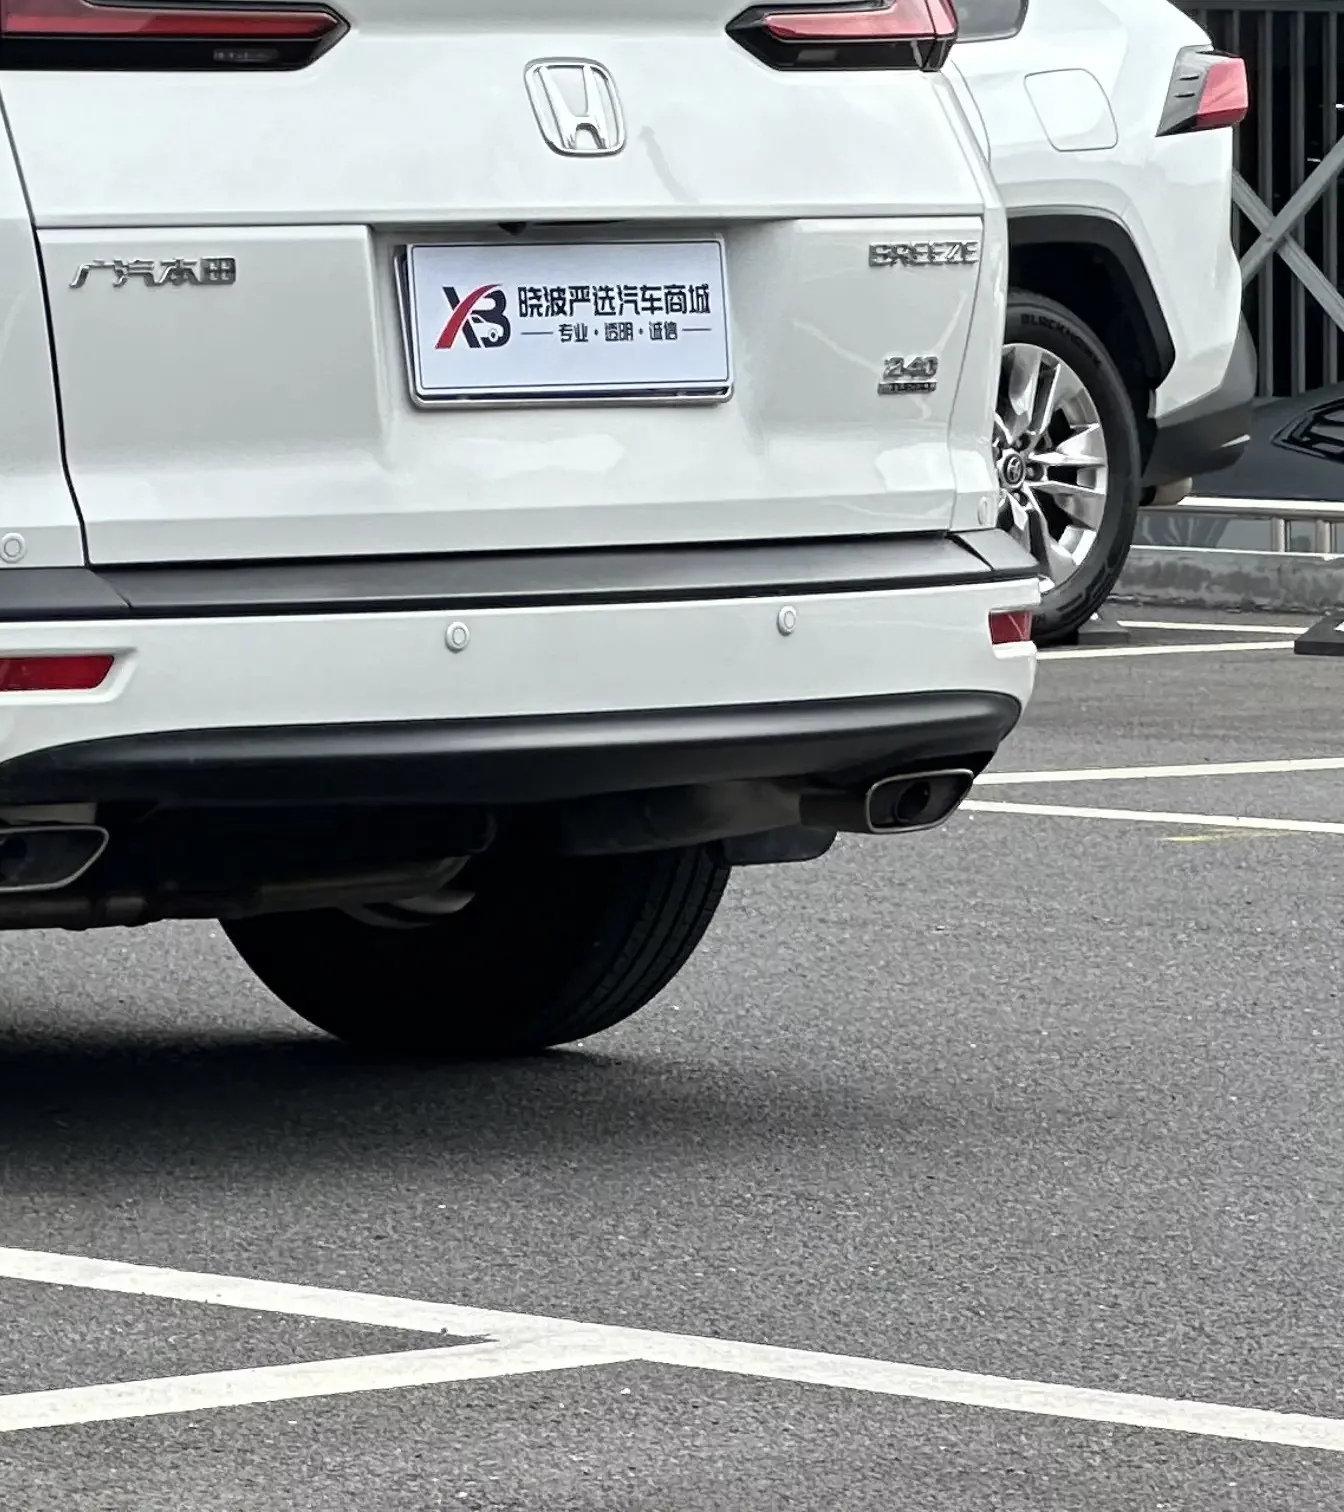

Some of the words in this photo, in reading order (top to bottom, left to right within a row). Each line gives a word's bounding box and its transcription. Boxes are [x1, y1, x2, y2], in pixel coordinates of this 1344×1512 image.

[869, 241, 979, 267] BREEZE
[69, 257, 236, 288] 广汽本田
[518, 284, 711, 317] 晓波严选汽车商城
[883, 356, 938, 380] 240
